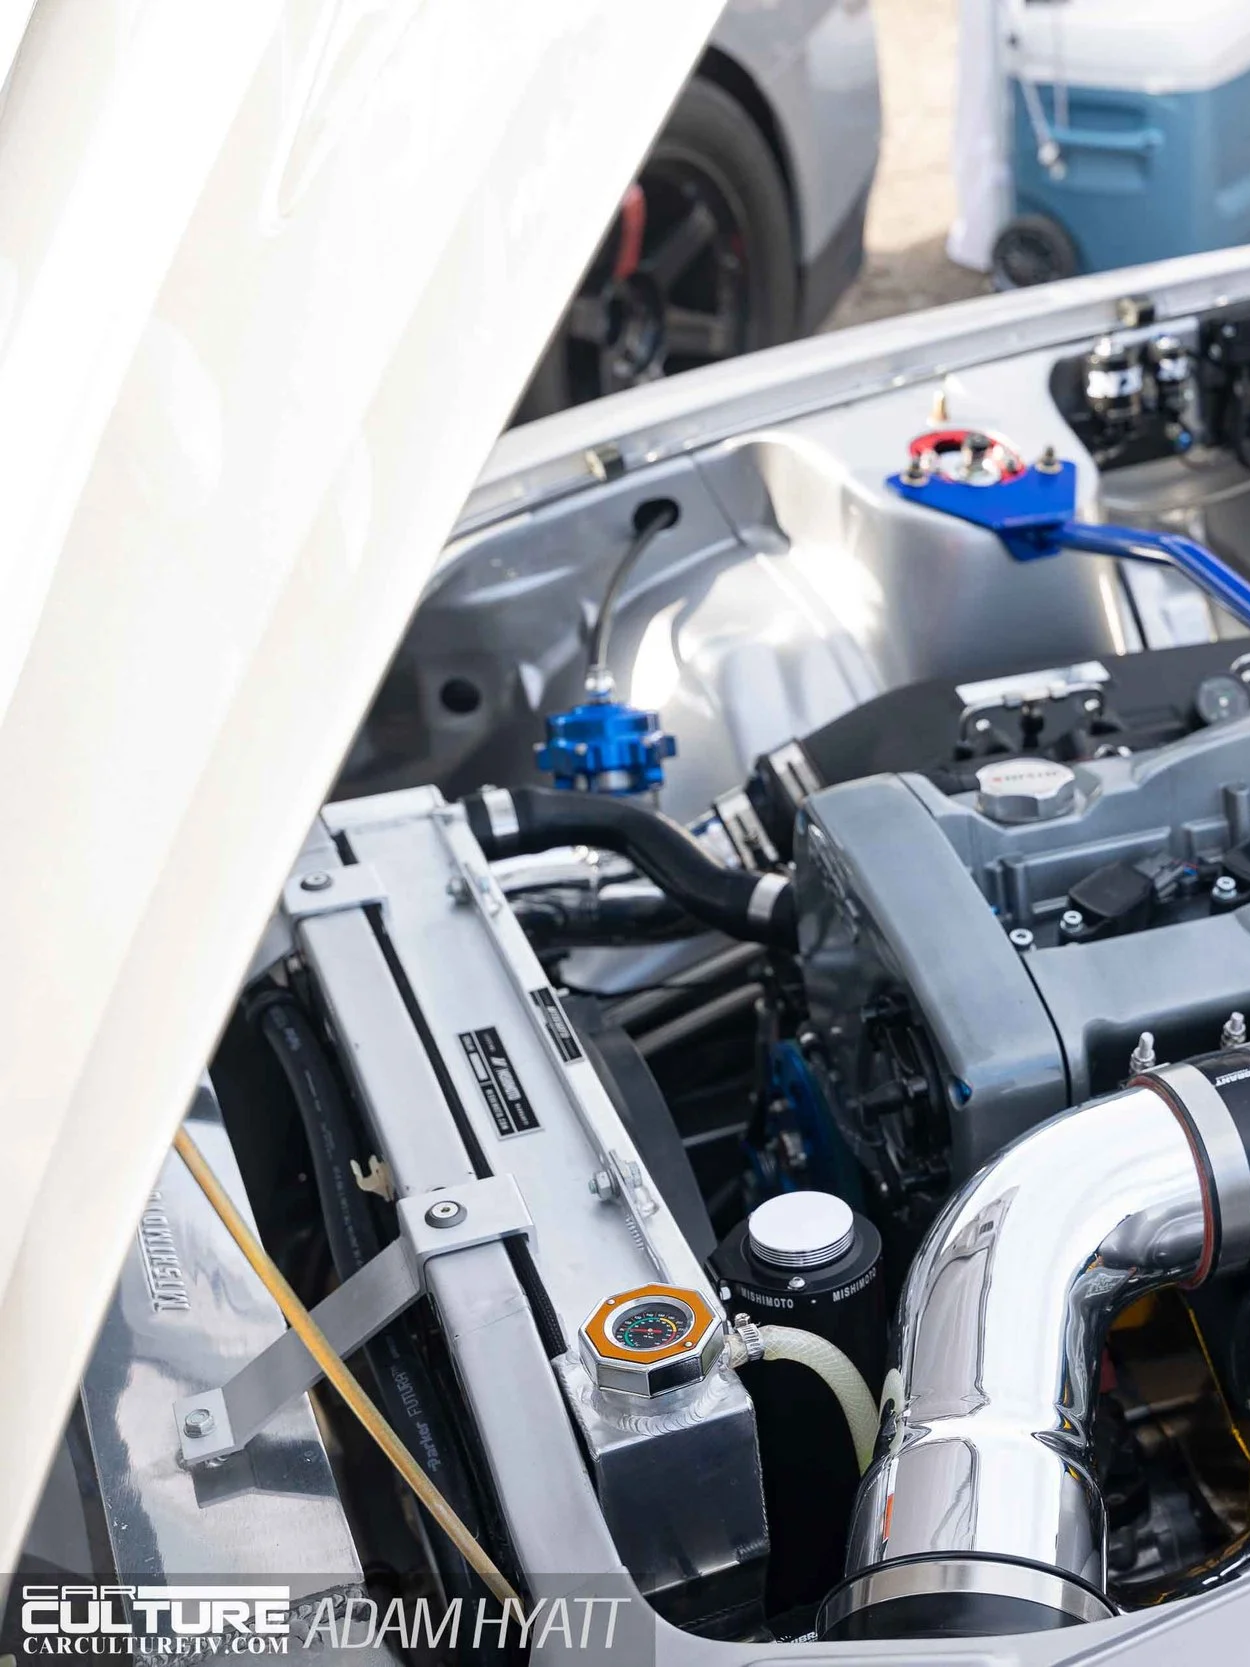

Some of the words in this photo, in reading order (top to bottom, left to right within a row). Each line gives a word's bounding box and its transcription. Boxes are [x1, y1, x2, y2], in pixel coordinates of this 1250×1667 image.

[740, 1286, 794, 1309] MISHIMOTO
[832, 1267, 877, 1303] MISHIMOTO
[416, 1422, 442, 1472] Parker
